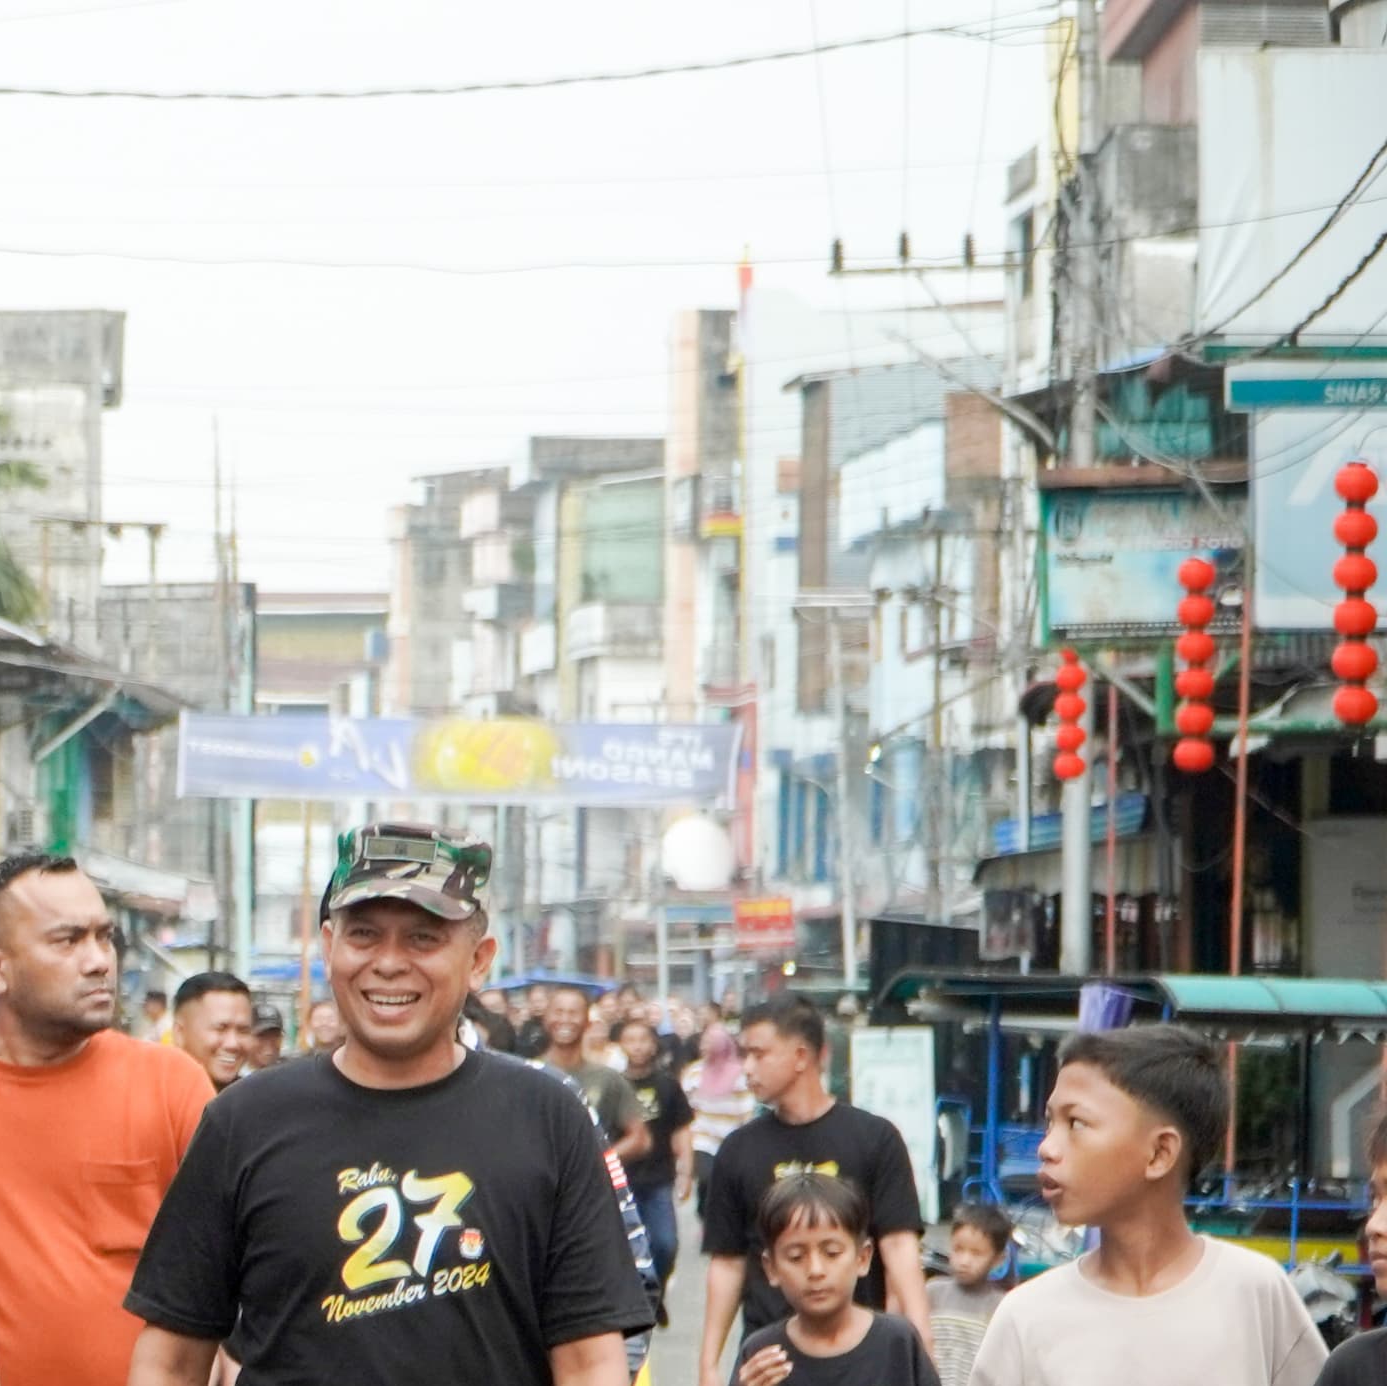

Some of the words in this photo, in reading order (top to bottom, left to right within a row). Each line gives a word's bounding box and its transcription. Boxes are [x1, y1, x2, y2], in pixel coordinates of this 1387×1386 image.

[337, 1171, 475, 1291] 27
[321, 1278, 426, 1322] November
[432, 1262, 491, 1296] 2024
